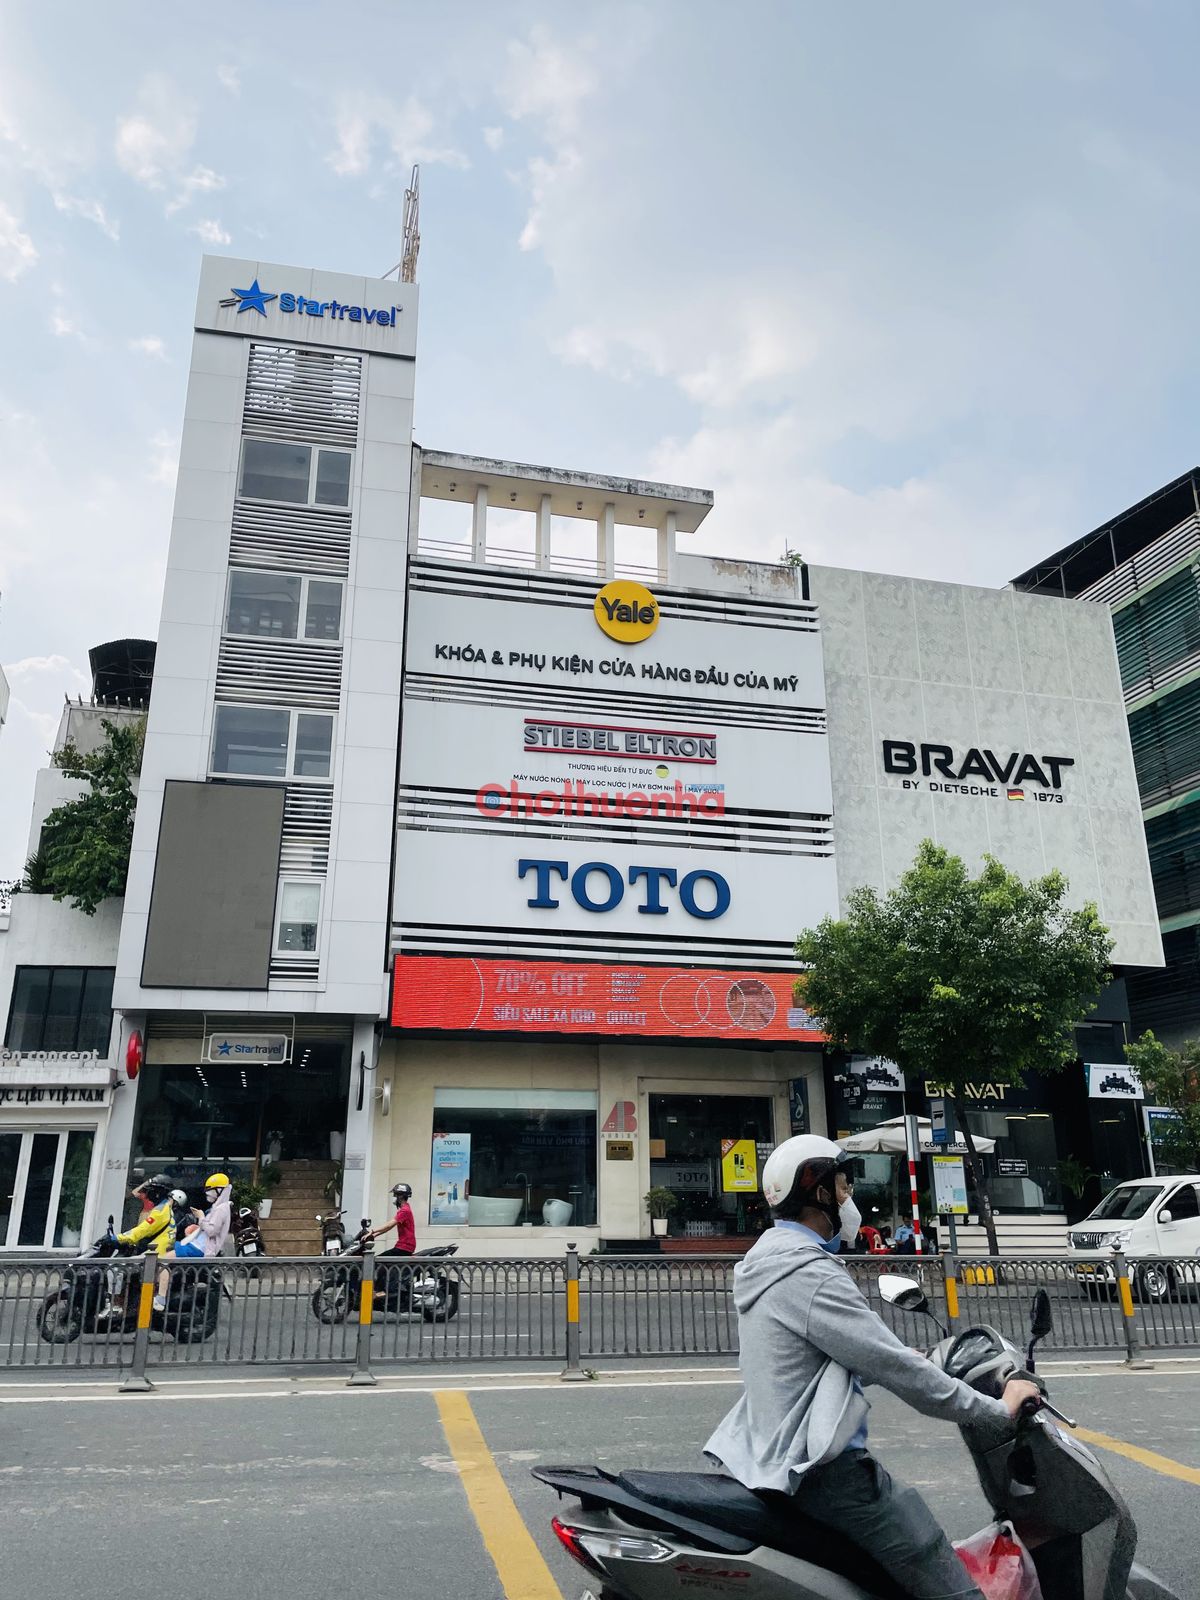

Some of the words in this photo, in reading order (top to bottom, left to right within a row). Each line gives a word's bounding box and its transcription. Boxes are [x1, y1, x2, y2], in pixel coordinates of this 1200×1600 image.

[279, 292, 396, 327] Startravel
[600, 596, 655, 624] Yale
[435, 643, 487, 664] KHÓA
[491, 650, 504, 665] &
[509, 651, 546, 672] PHỤ
[552, 654, 594, 675] KIỆN
[599, 657, 636, 677] CỬA
[641, 662, 692, 682] HÀNG
[694, 665, 729, 686] ĐẦU
[733, 670, 770, 690] CỦA
[773, 675, 799, 692] MỸ
[524, 725, 620, 751] STIEBEL
[624, 733, 717, 758] ELTRON
[882, 740, 1075, 789] BRAVAT
[902, 780, 920, 790] BY
[929, 782, 999, 797] DIETSCHE
[1033, 792, 1064, 803] 1873
[518, 858, 731, 920] TOTO
[28, 1049, 100, 1064] concept
[234, 1043, 281, 1054] Startravel
